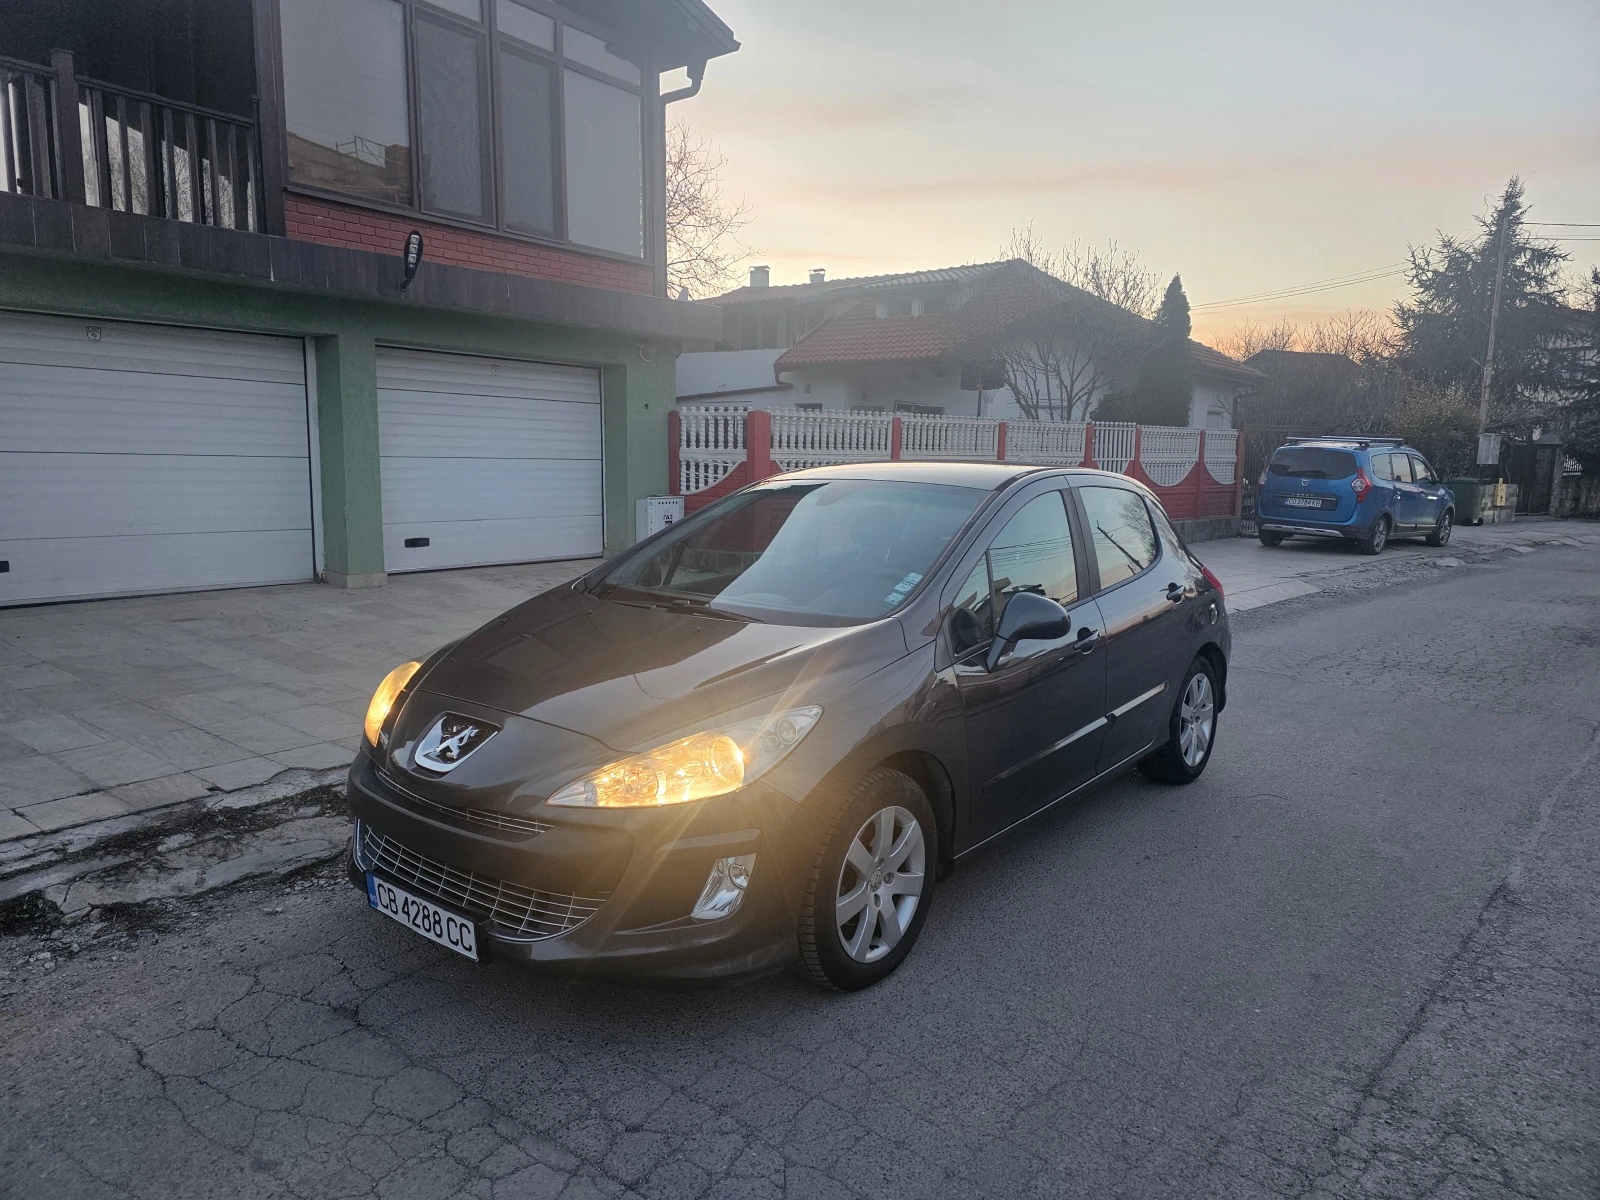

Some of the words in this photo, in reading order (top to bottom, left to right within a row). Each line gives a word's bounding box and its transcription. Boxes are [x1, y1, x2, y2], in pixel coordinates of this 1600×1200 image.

[377, 883, 398, 915] CB
[402, 896, 443, 939] 4288
[446, 917, 473, 952] CC
